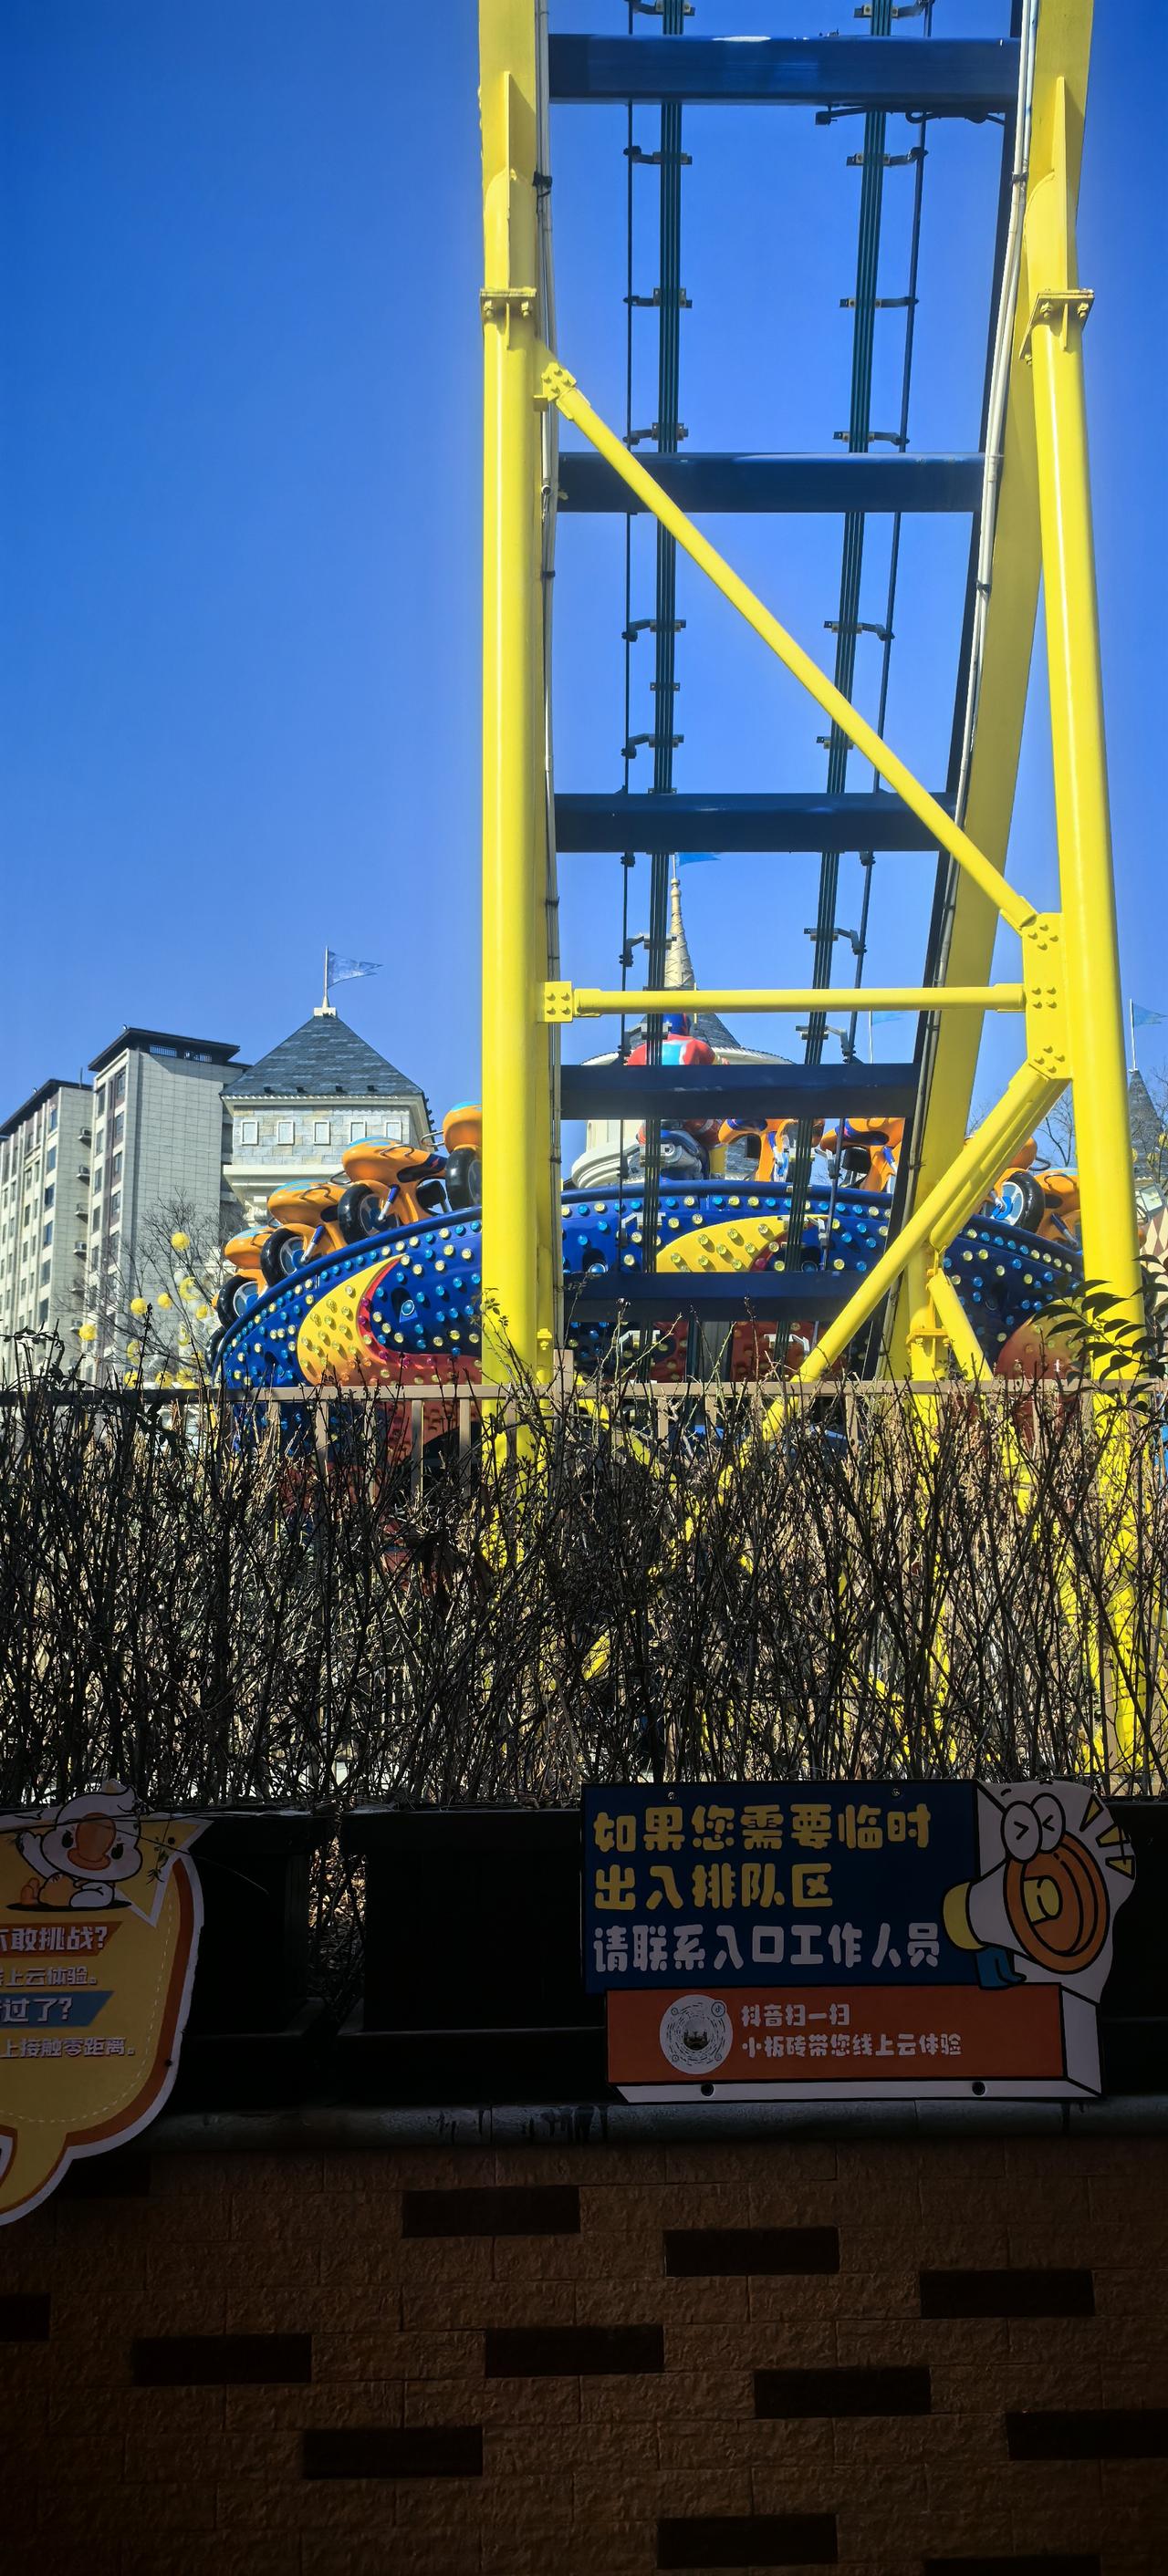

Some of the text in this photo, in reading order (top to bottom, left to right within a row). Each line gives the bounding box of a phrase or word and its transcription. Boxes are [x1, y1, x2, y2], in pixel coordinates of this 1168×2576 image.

[594, 1803, 931, 1852] 如果您需要临时
[594, 1863, 833, 1910] 出入排队区
[593, 1922, 940, 1971] 请联系入口工作人员
[741, 2003, 850, 2026] 抖音扫一扫
[741, 2033, 962, 2057] 小板砖带您线上云体验
